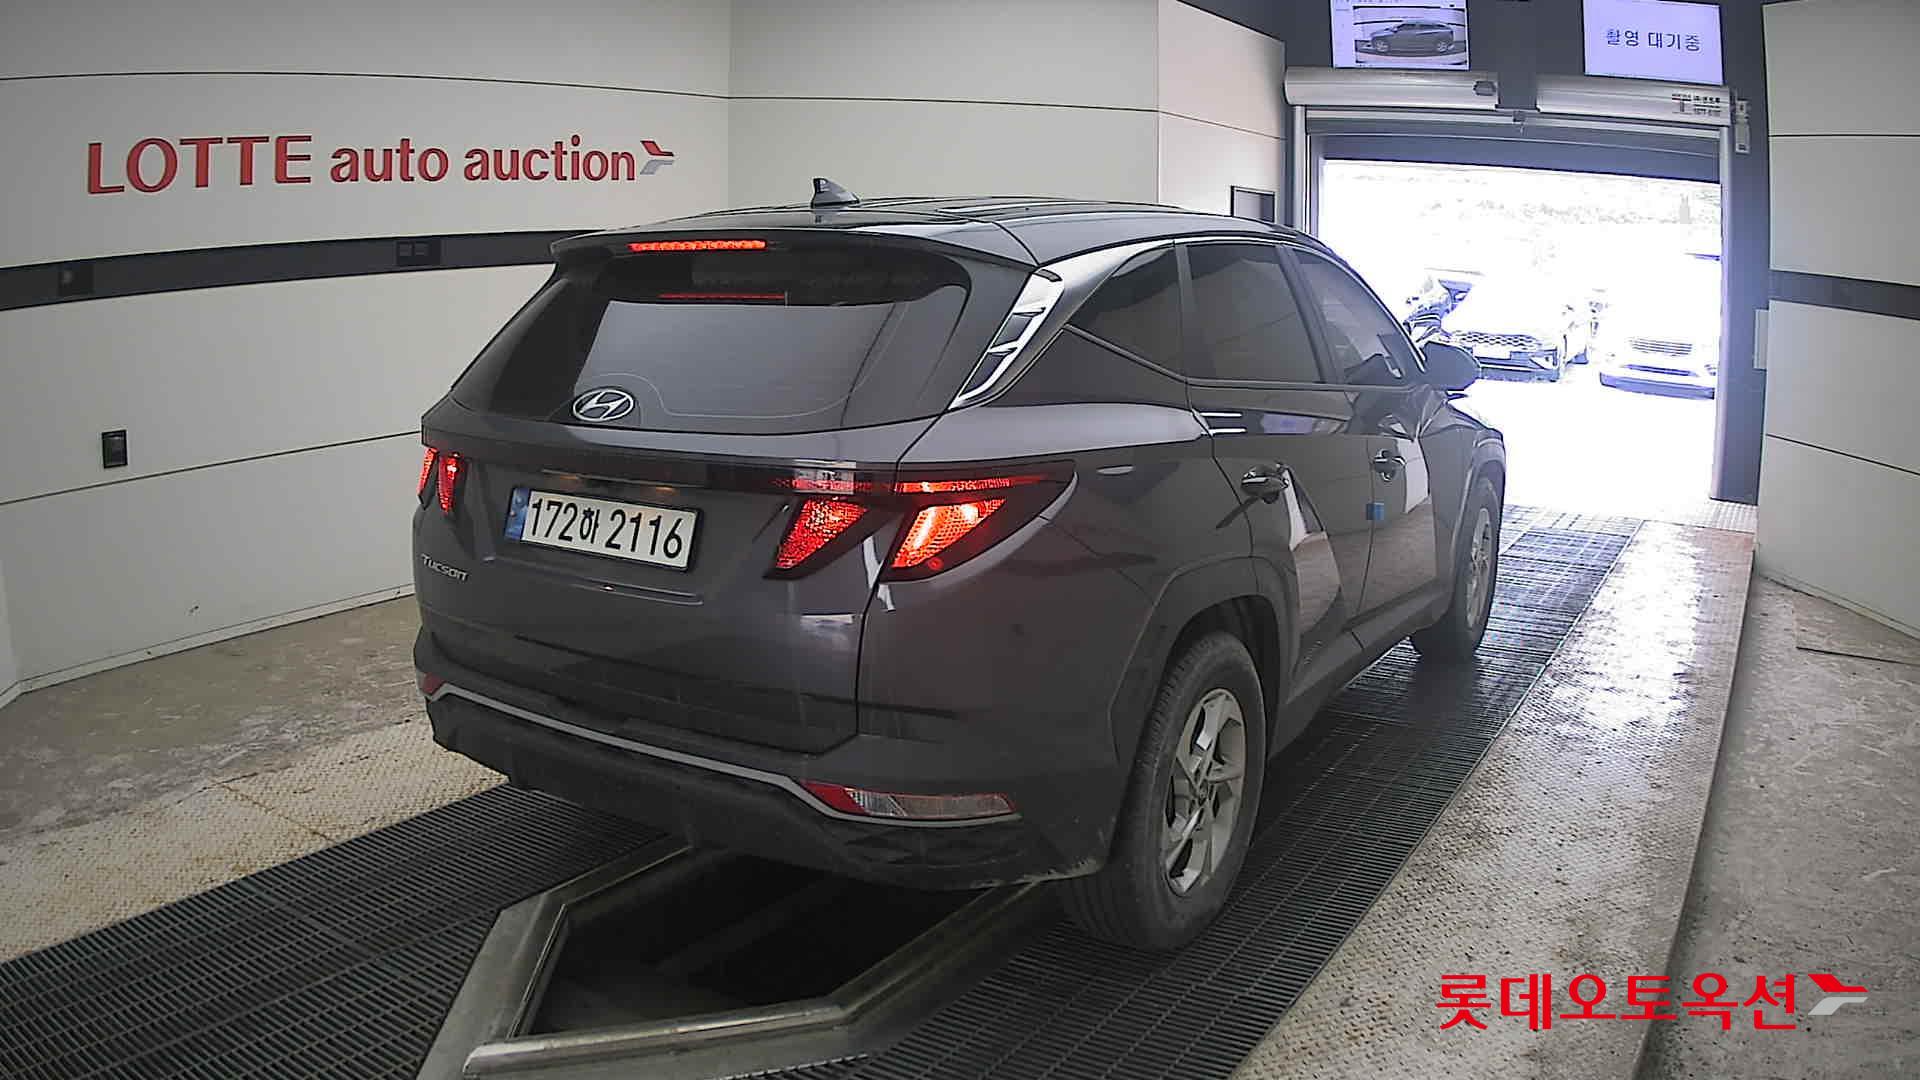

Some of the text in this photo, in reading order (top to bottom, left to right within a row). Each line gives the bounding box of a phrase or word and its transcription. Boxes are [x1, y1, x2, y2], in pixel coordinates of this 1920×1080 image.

[1648, 32, 1700, 51] 대기중
[88, 134, 635, 194] LOTTE auto auction
[532, 498, 682, 559] 172하 2116
